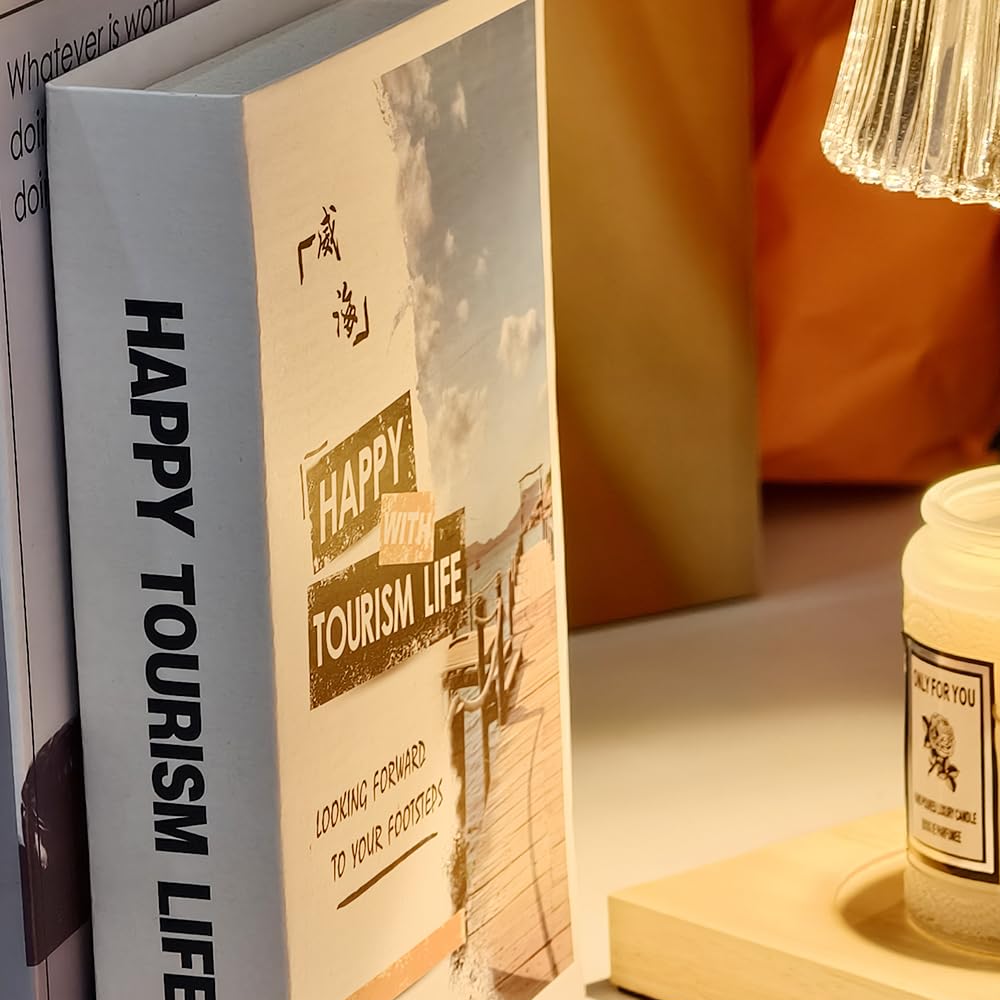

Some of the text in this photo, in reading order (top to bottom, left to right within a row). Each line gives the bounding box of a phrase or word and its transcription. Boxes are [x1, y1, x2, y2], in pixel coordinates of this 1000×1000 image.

[7, 26, 104, 99] Whatever
[108, 13, 120, 51] is
[125, 299, 196, 538] HAPPY
[318, 416, 405, 545] HAPPY
[382, 511, 433, 546] WITH
[312, 549, 463, 668] TOURISM LIFE
[141, 564, 209, 855] TOURISM
[930, 678, 950, 702] FOR
[951, 684, 976, 707] YOU
[315, 740, 426, 839] LOOKING FORWARD
[330, 777, 444, 882] TO YOUR FOOTSTEPS
